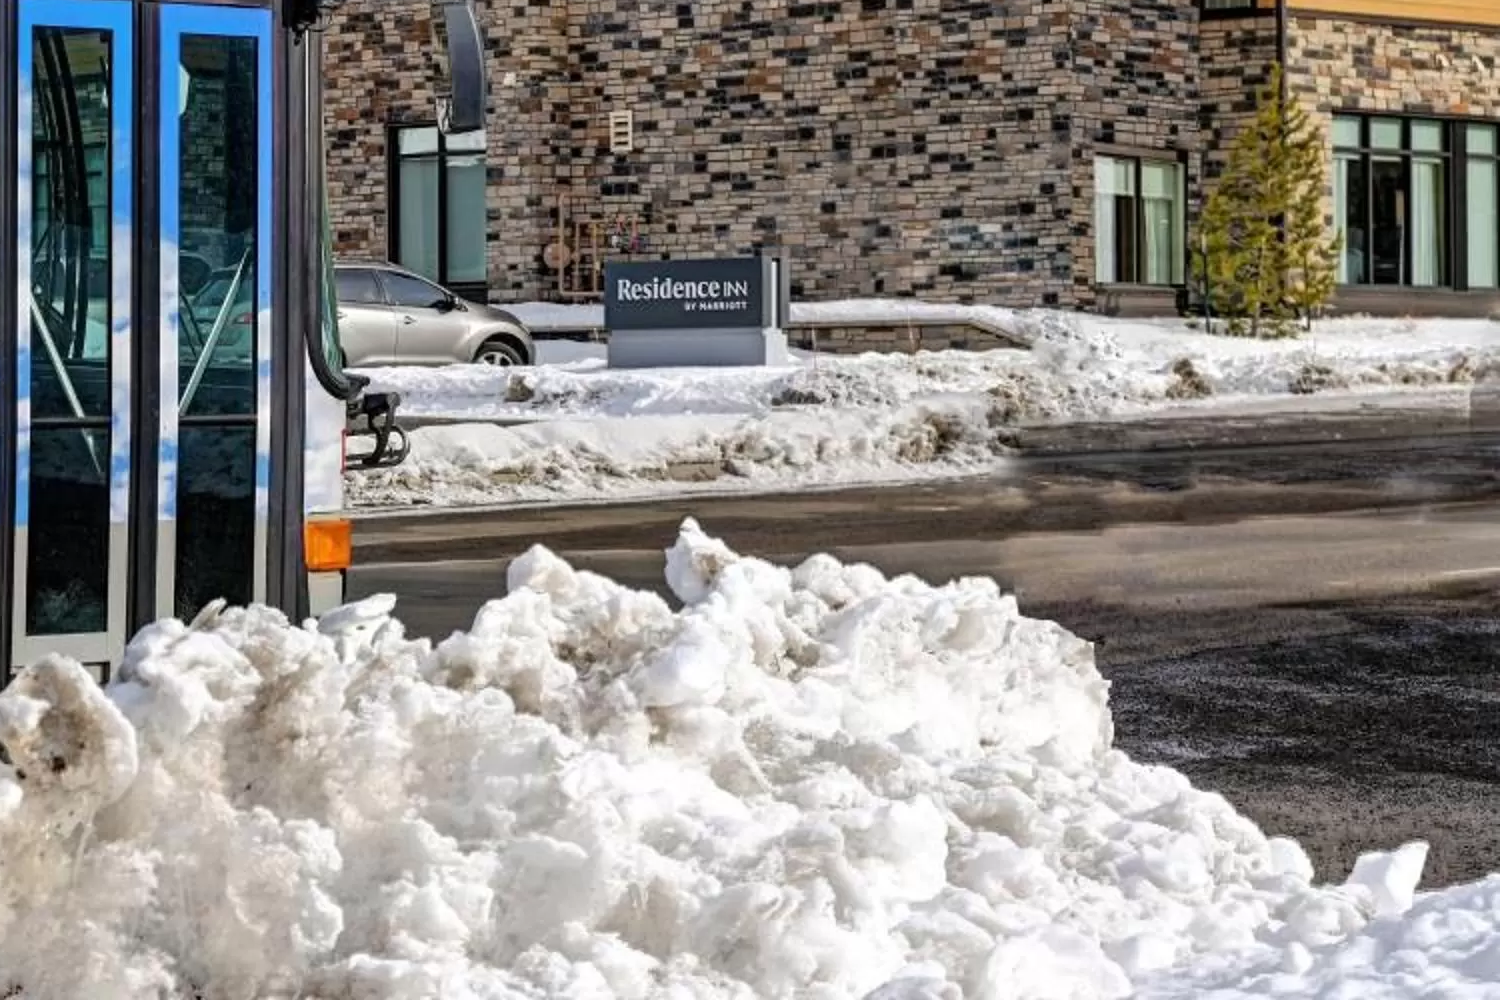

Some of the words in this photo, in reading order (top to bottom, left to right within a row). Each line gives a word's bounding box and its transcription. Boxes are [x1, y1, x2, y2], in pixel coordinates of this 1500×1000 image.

[617, 276, 721, 302] Residence
[723, 280, 748, 298] INN
[684, 301, 698, 311] BY
[699, 300, 748, 311] MARRIOTT
